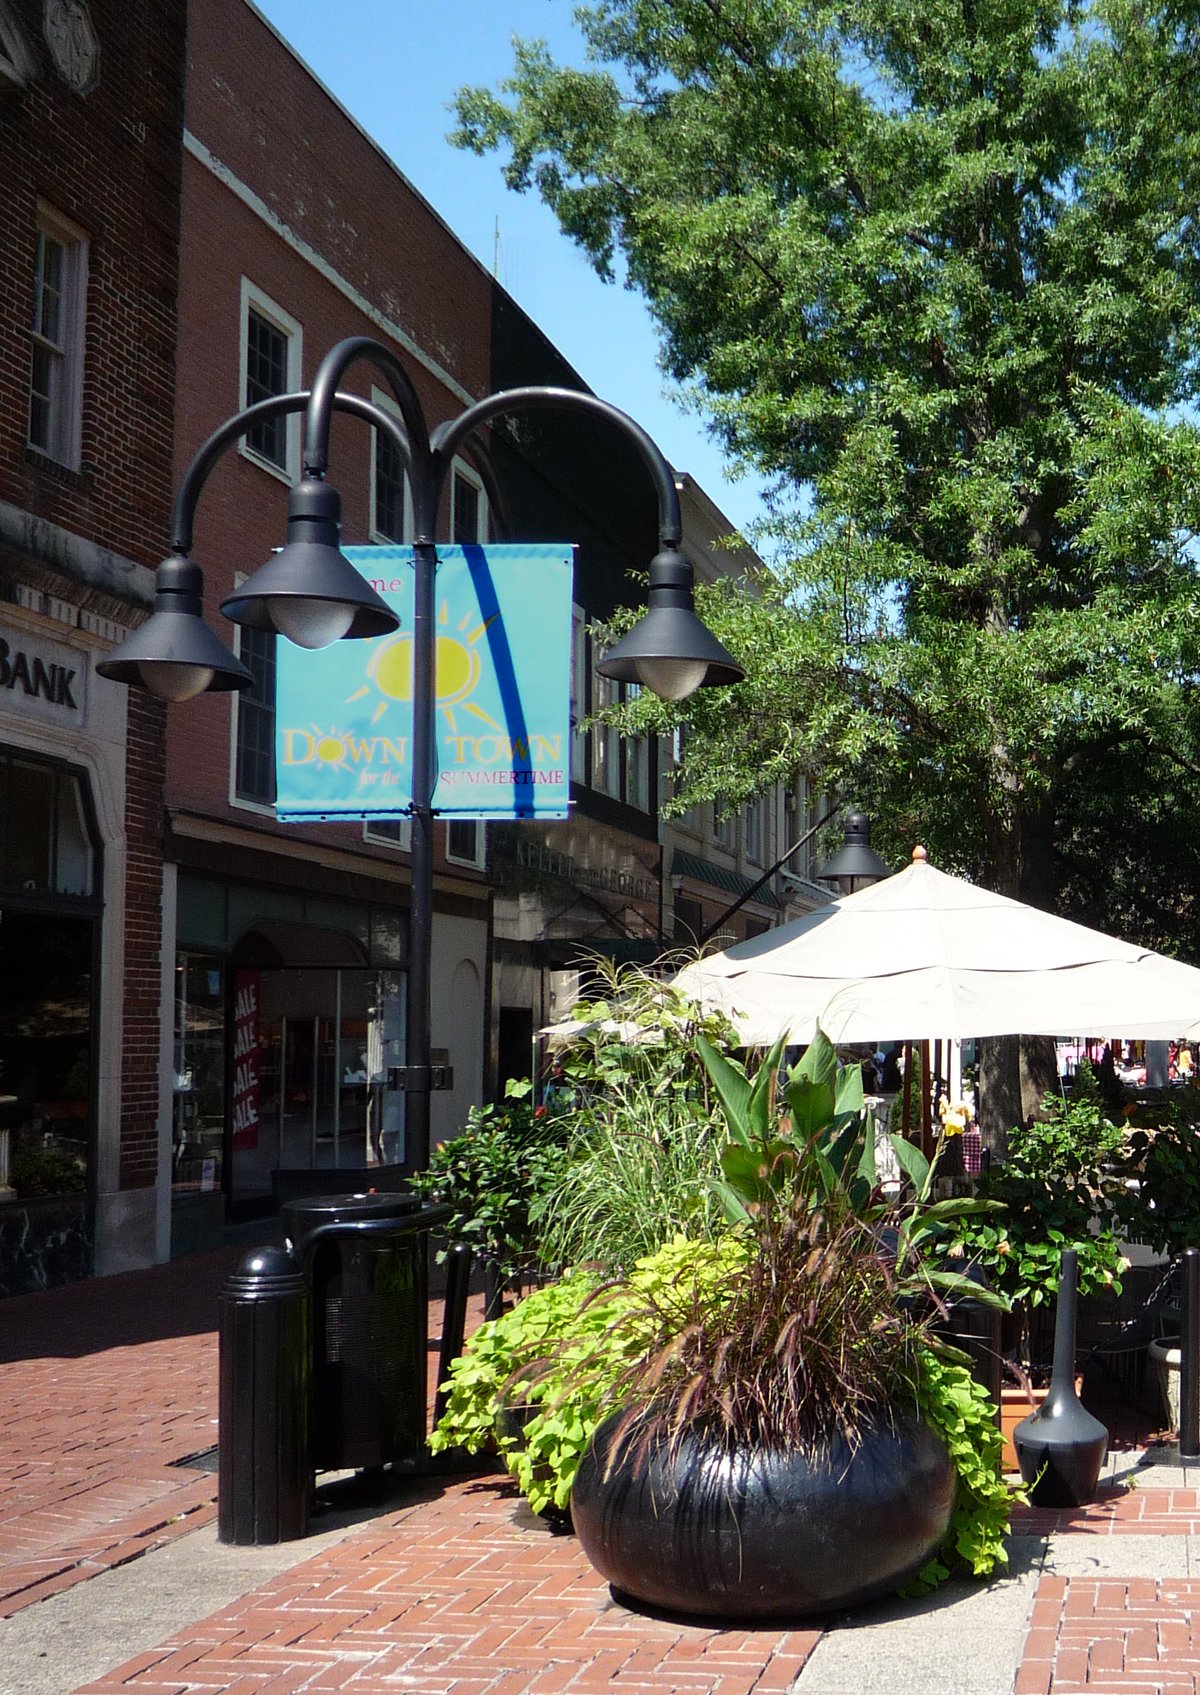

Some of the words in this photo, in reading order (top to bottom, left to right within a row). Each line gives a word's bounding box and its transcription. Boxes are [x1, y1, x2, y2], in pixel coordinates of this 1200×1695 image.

[281, 729, 409, 766] DOWN
[445, 733, 561, 764] TOWN
[440, 769, 565, 786] SUMMERTIME
[234, 983, 257, 1022] ALE
[233, 1021, 258, 1060] ALE
[233, 1057, 259, 1098] ALE
